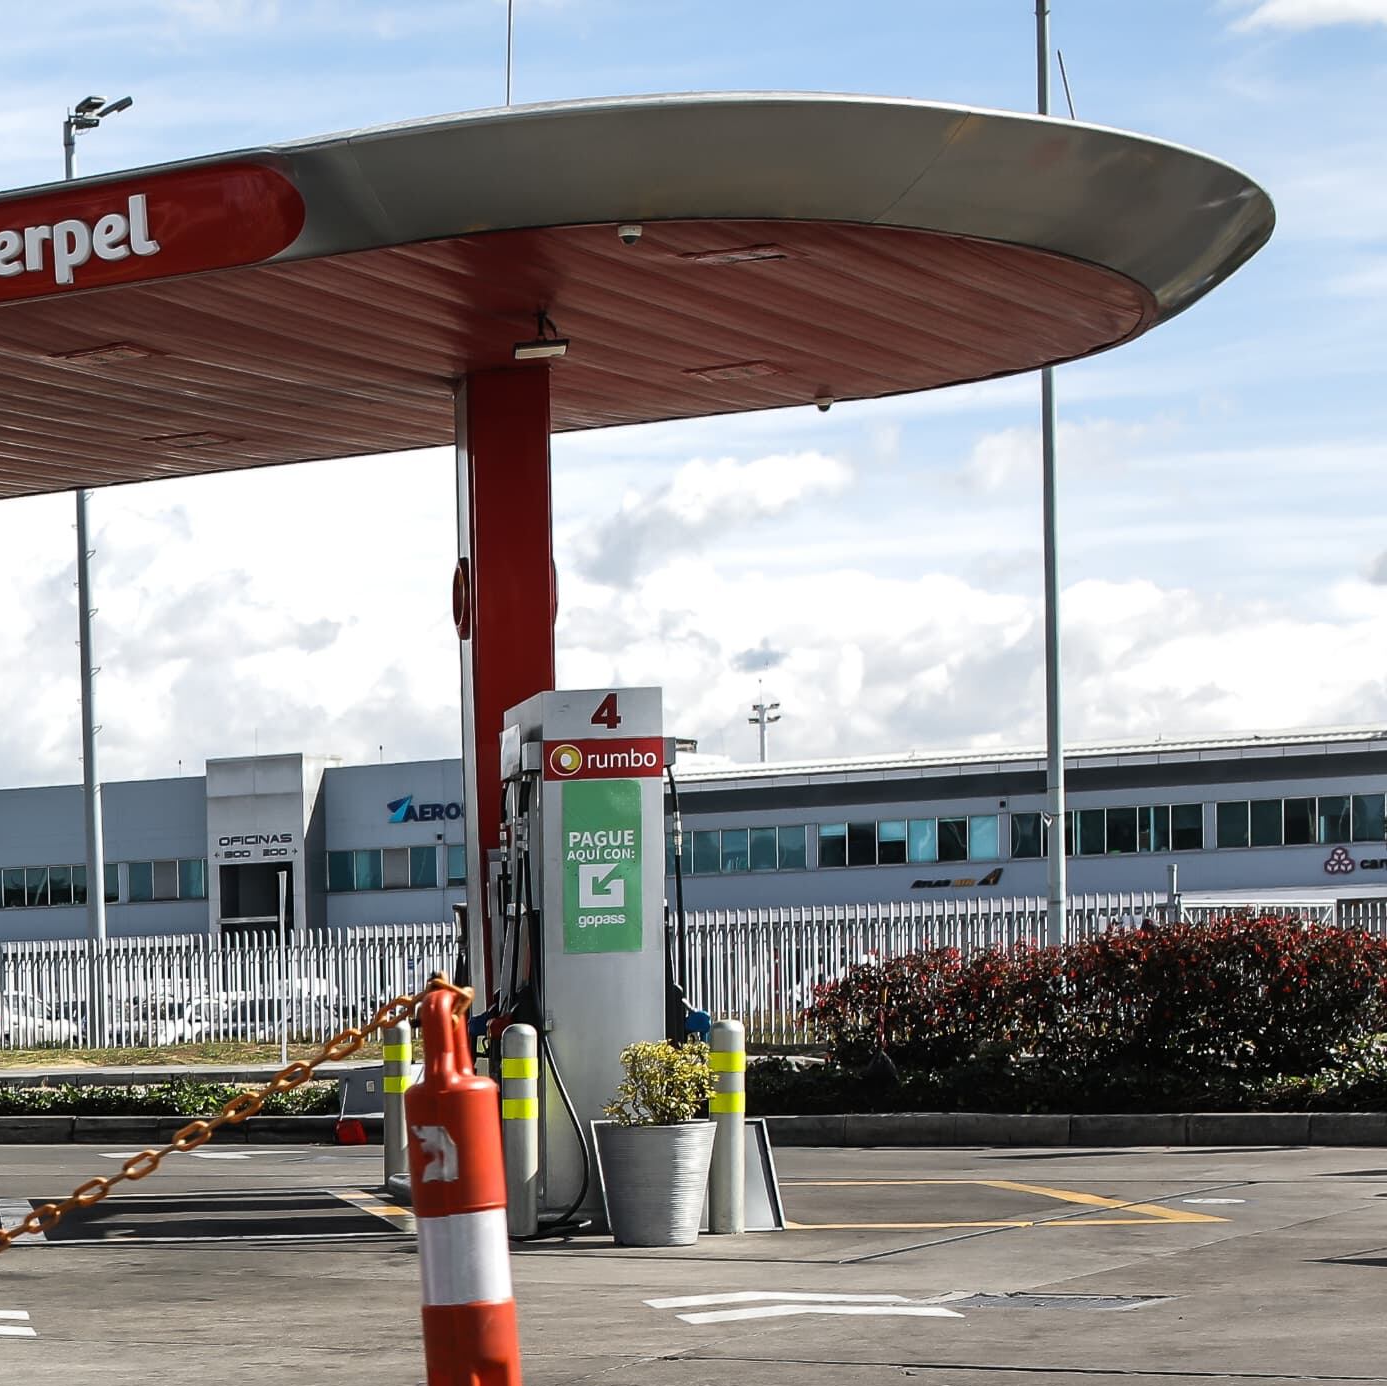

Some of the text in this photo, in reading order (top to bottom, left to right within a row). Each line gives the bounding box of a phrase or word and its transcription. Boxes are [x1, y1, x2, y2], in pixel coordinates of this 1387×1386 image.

[591, 693, 621, 729] 4
[587, 748, 657, 769] rumbo
[403, 802, 464, 822] AERO
[219, 833, 292, 846] OFICINAS
[569, 830, 635, 847] PAGUE
[567, 846, 635, 862] AQUÍ CON:
[578, 914, 626, 928] gopass
